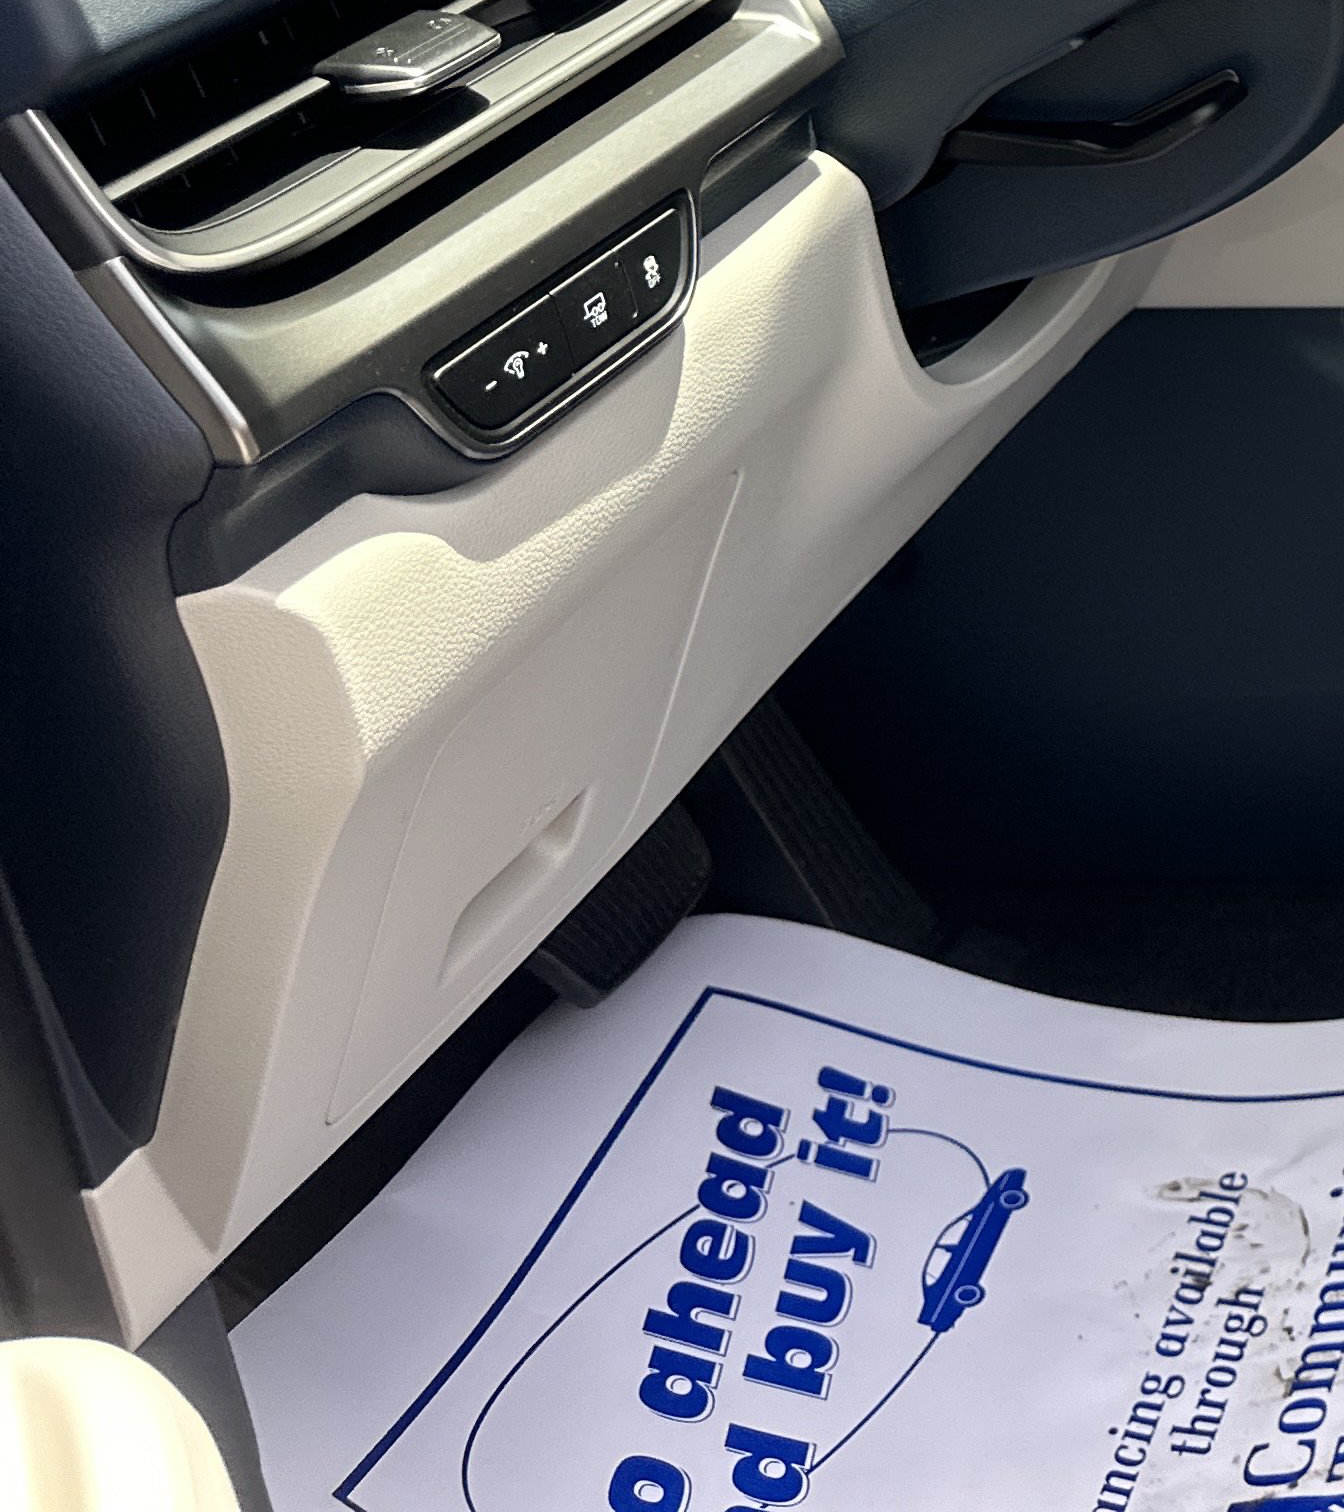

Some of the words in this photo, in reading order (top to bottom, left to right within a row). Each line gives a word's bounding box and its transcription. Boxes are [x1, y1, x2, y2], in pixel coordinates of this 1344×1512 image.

[796, 1065, 896, 1183] it!
[639, 1085, 791, 1423] ahead
[742, 1198, 877, 1401] buy
[1154, 1170, 1249, 1358] available
[1169, 1286, 1269, 1456] through
